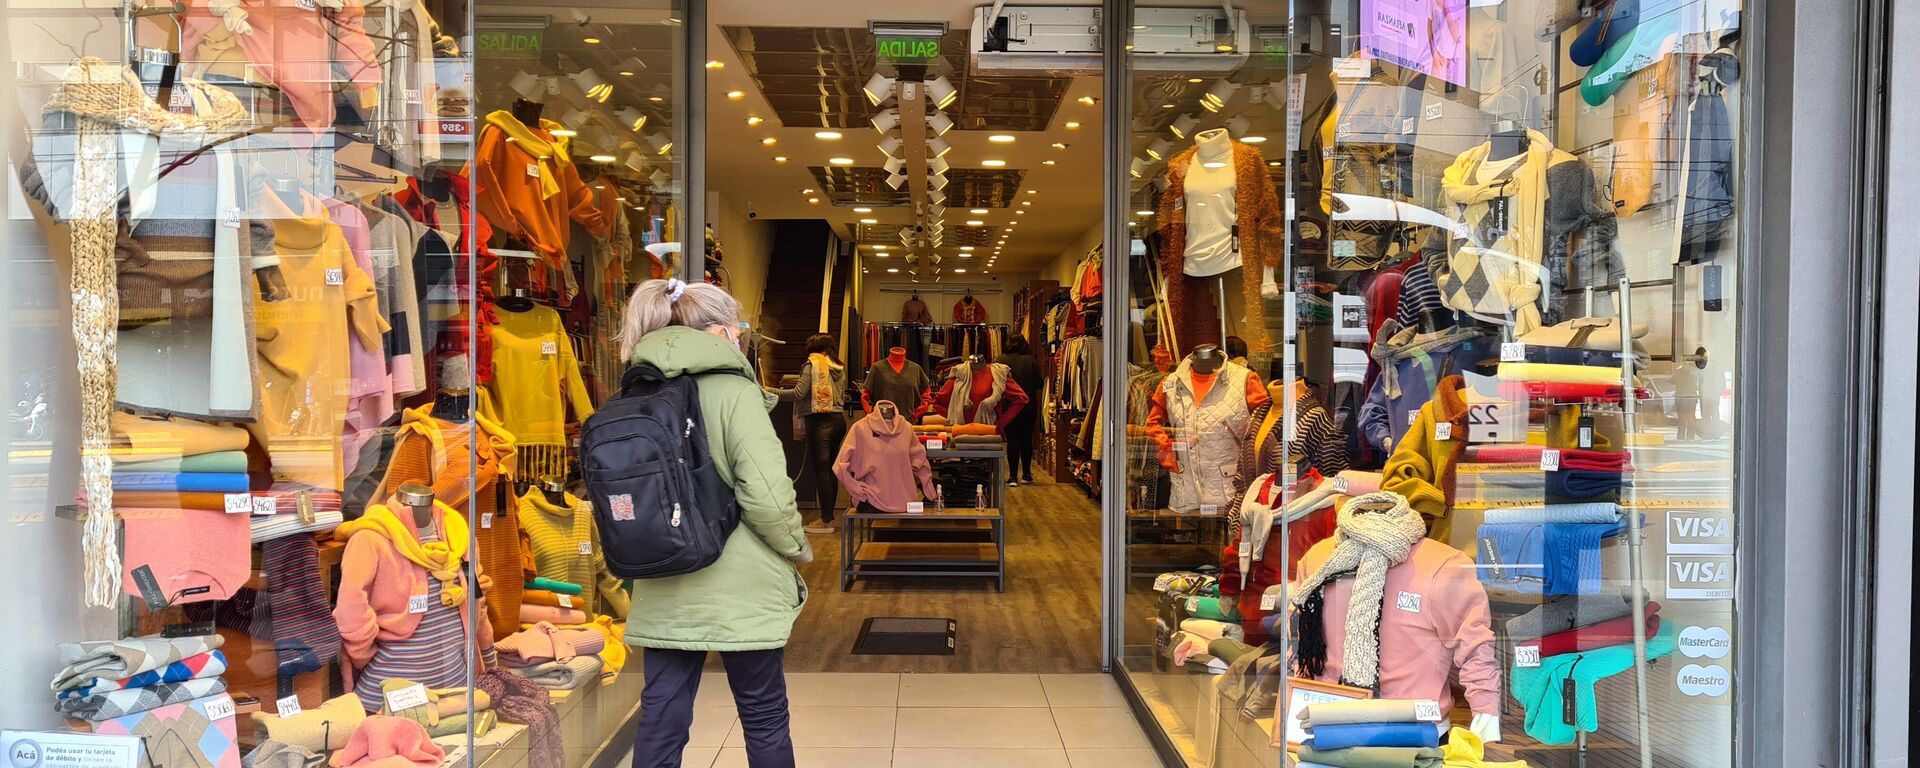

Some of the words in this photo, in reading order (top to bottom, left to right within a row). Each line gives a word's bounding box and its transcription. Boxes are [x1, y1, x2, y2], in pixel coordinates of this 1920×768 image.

[480, 34, 539, 51] SALIDA
[1671, 517, 1730, 538] VISA
[1671, 561, 1730, 583] VISA
[1679, 637, 1730, 648] MasterCard
[1681, 675, 1725, 686] Maestro
[16, 749, 36, 761] Acá
[46, 747, 67, 755] Podés
[93, 749, 116, 757] tarjeta
